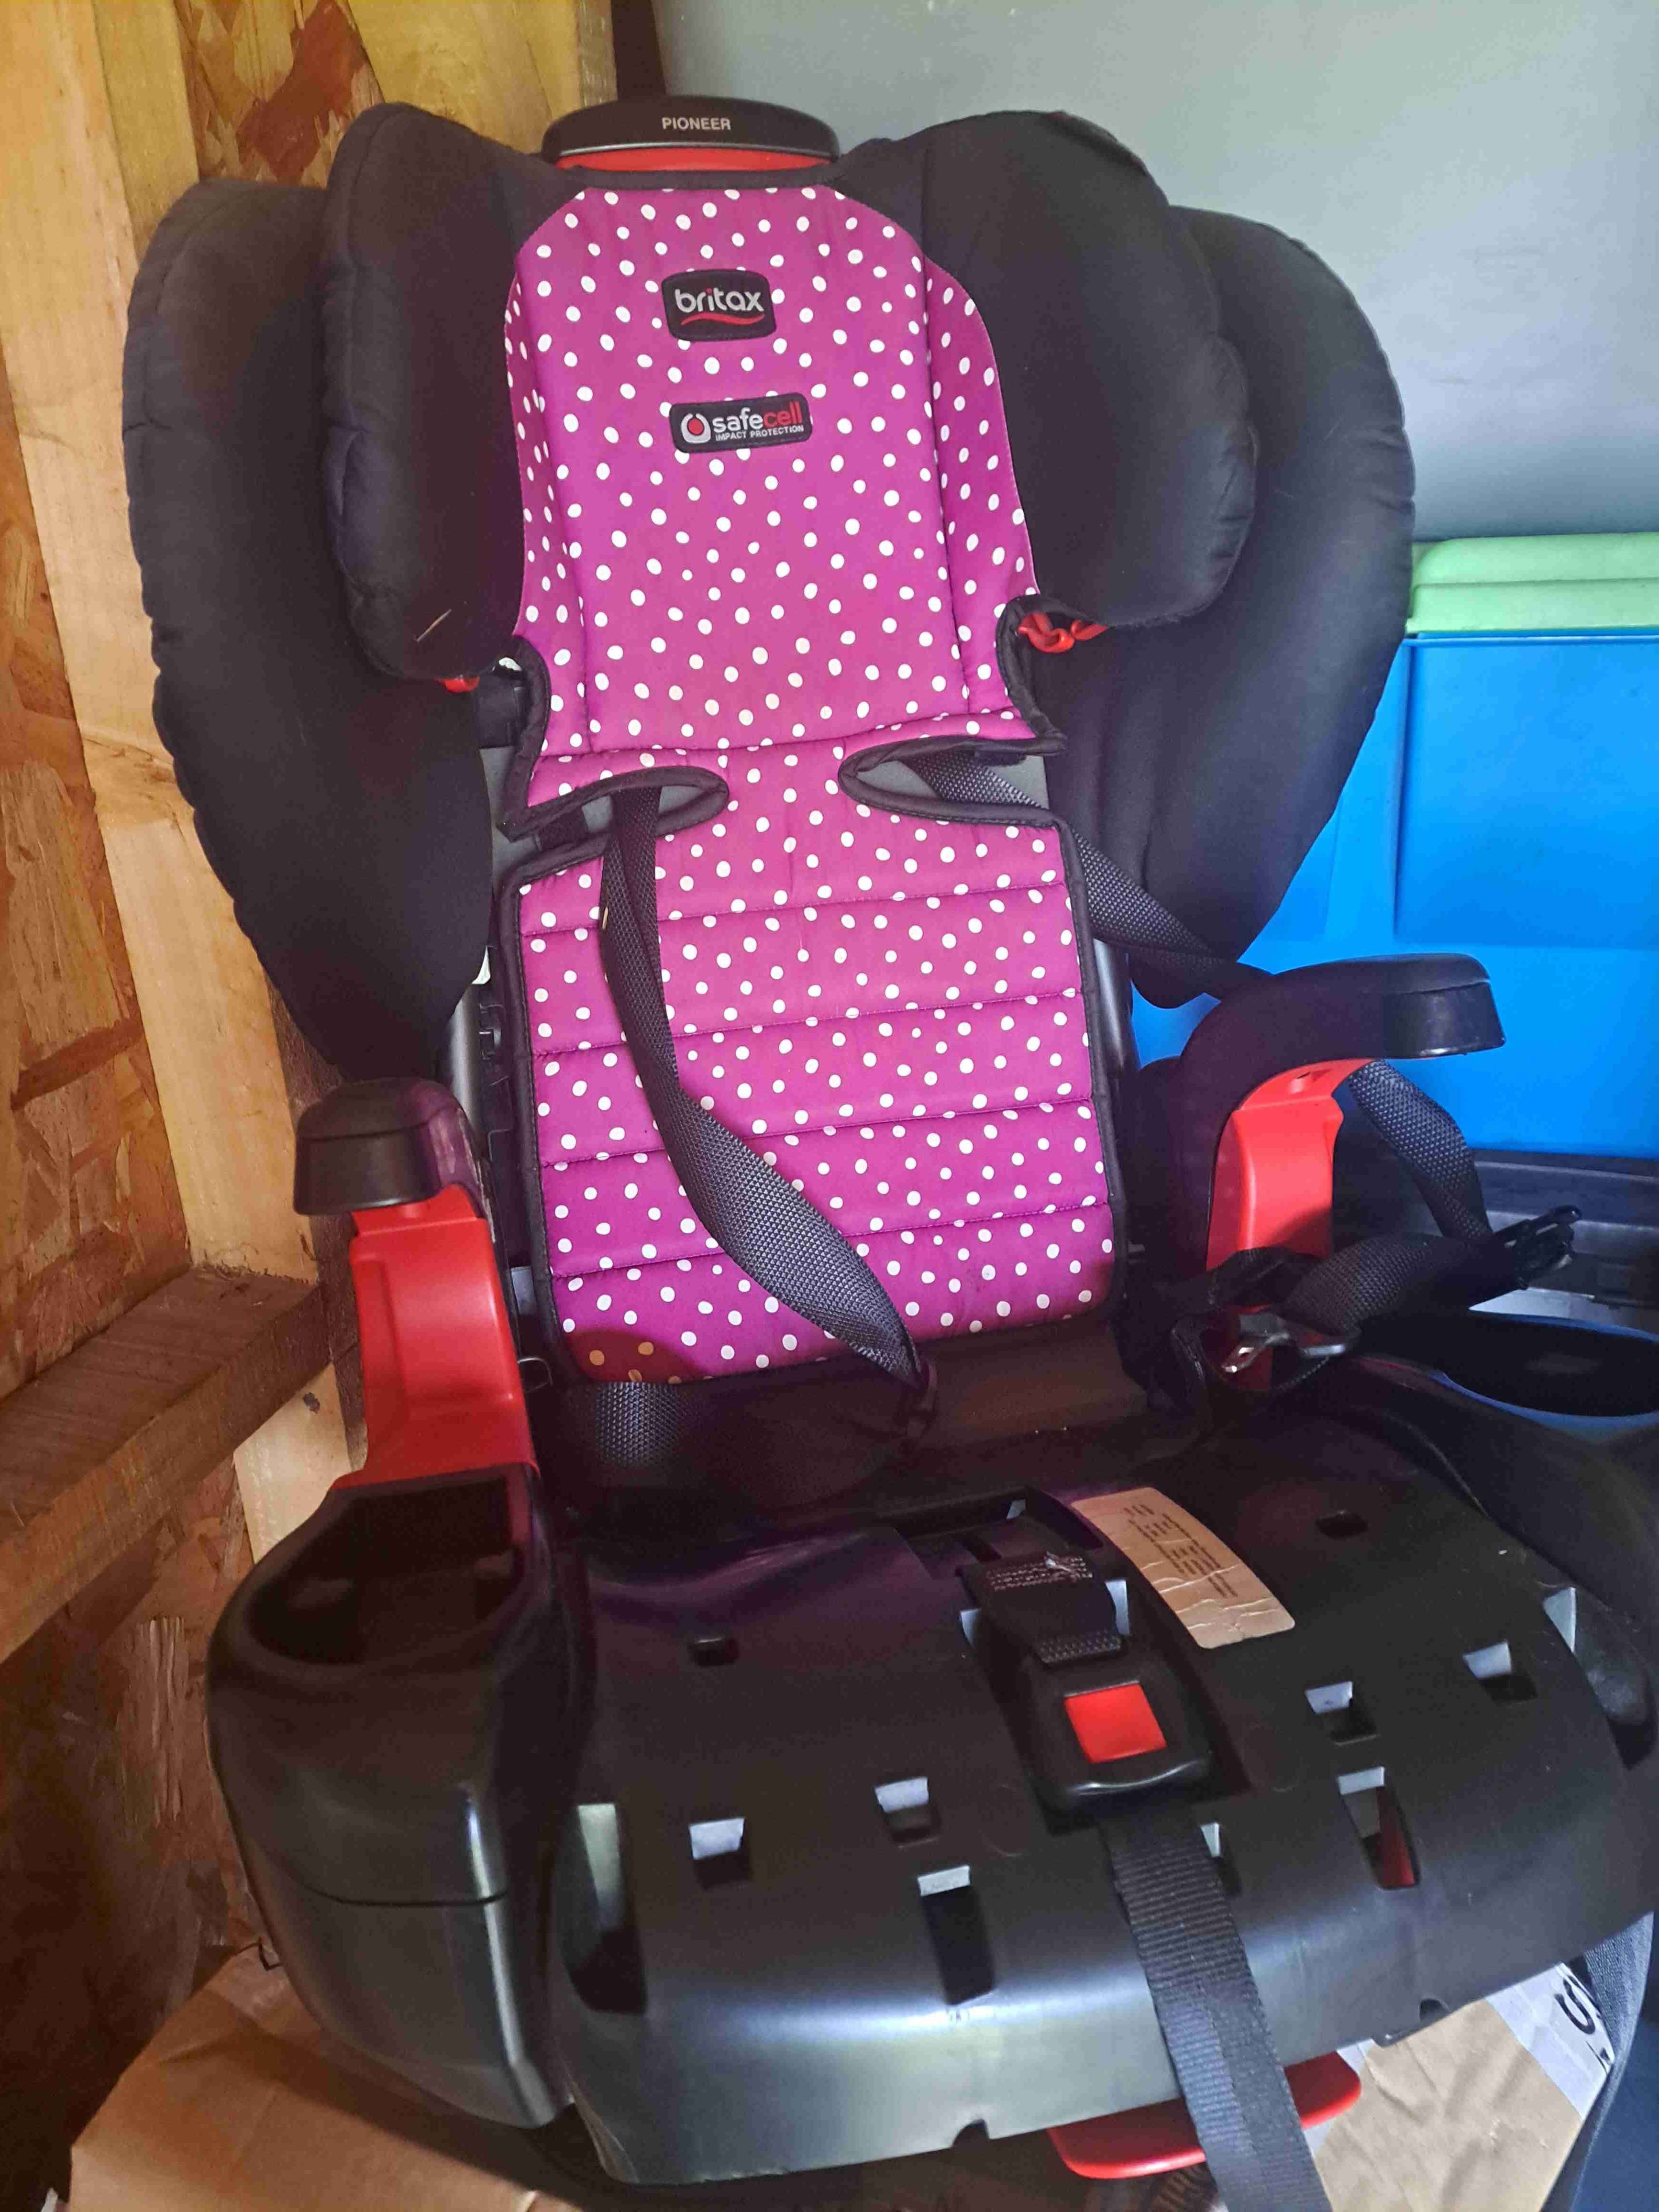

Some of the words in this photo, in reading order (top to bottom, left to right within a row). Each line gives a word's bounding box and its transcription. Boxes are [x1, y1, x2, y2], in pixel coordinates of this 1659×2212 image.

[661, 117, 731, 130] PIONEER
[675, 287, 764, 312] britax
[712, 401, 803, 433] safecell
[715, 430, 747, 441] IMPACT
[750, 424, 804, 439] PROTECTION
